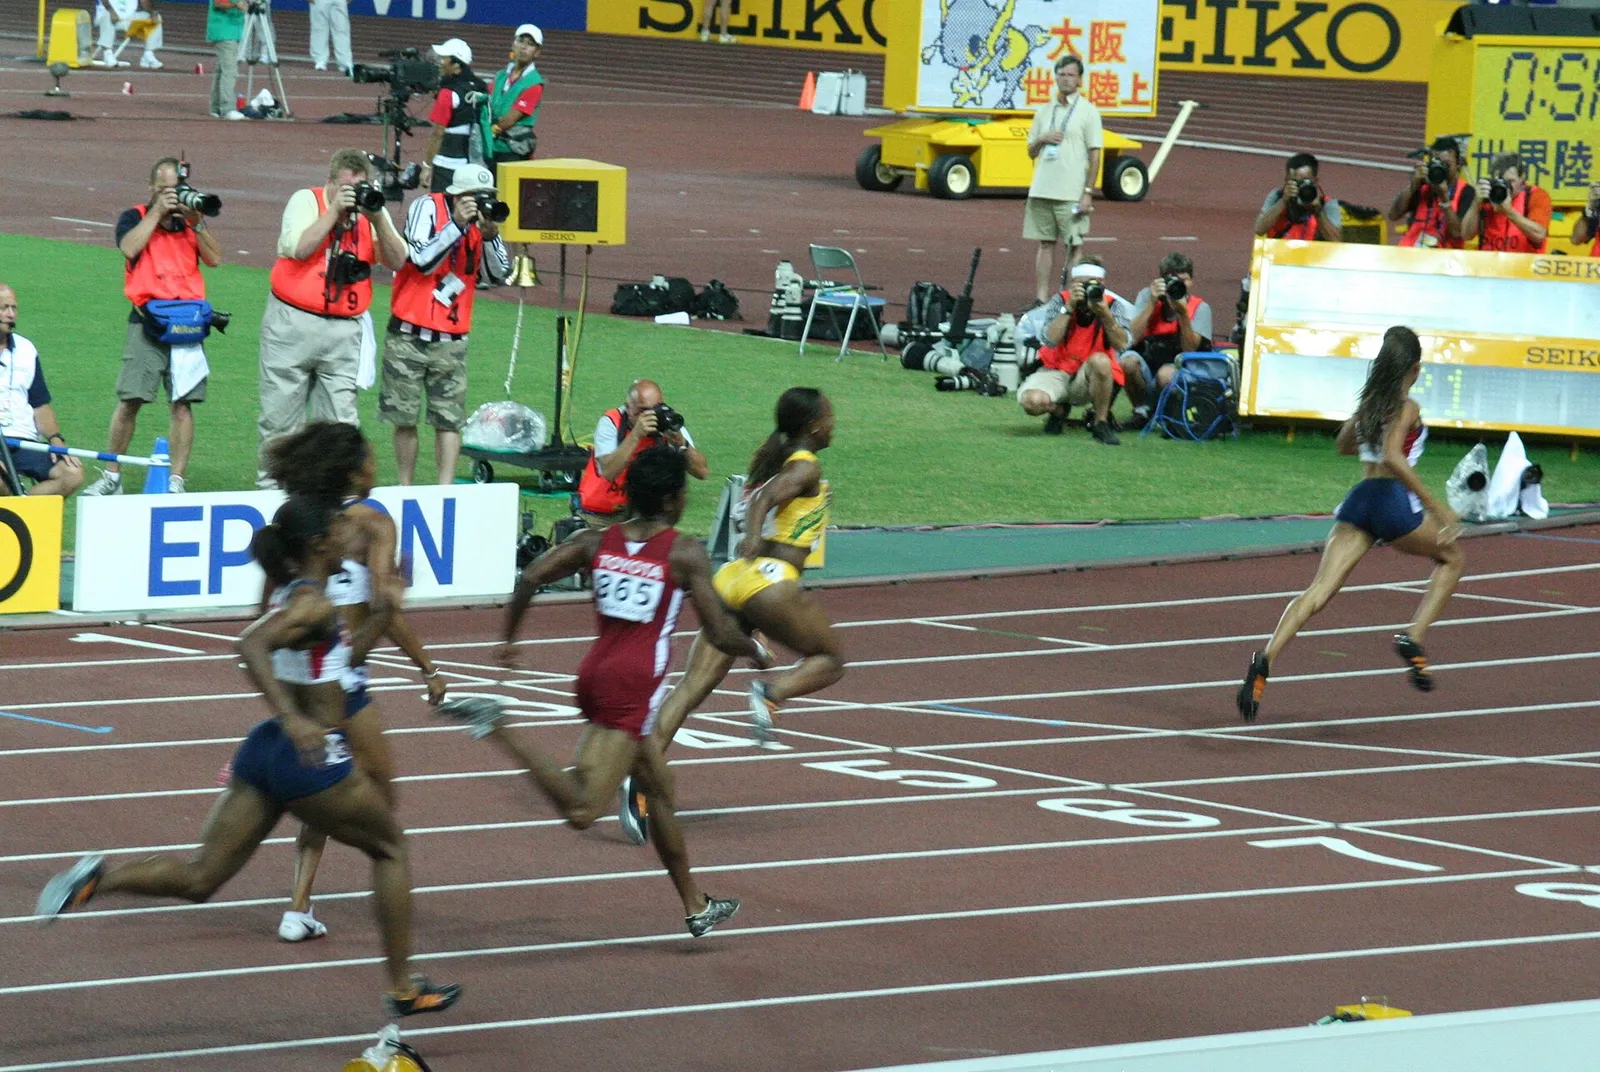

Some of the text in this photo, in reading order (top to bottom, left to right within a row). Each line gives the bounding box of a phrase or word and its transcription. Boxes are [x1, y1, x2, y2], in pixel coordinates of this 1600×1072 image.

[638, 0, 888, 47] SEIK
[1047, 17, 1127, 63] 大阪
[1158, 0, 1402, 73] EIKO
[1023, 68, 1151, 107] 世陸上
[1500, 52, 1600, 121] 0:5
[540, 232, 576, 241] SEIKO
[1526, 346, 1600, 367] SEIK
[148, 497, 457, 597] EPN
[599, 554, 664, 580] TOYOTA
[800, 759, 999, 789] 5
[1036, 798, 1222, 828] 6
[1245, 835, 1446, 872] 7
